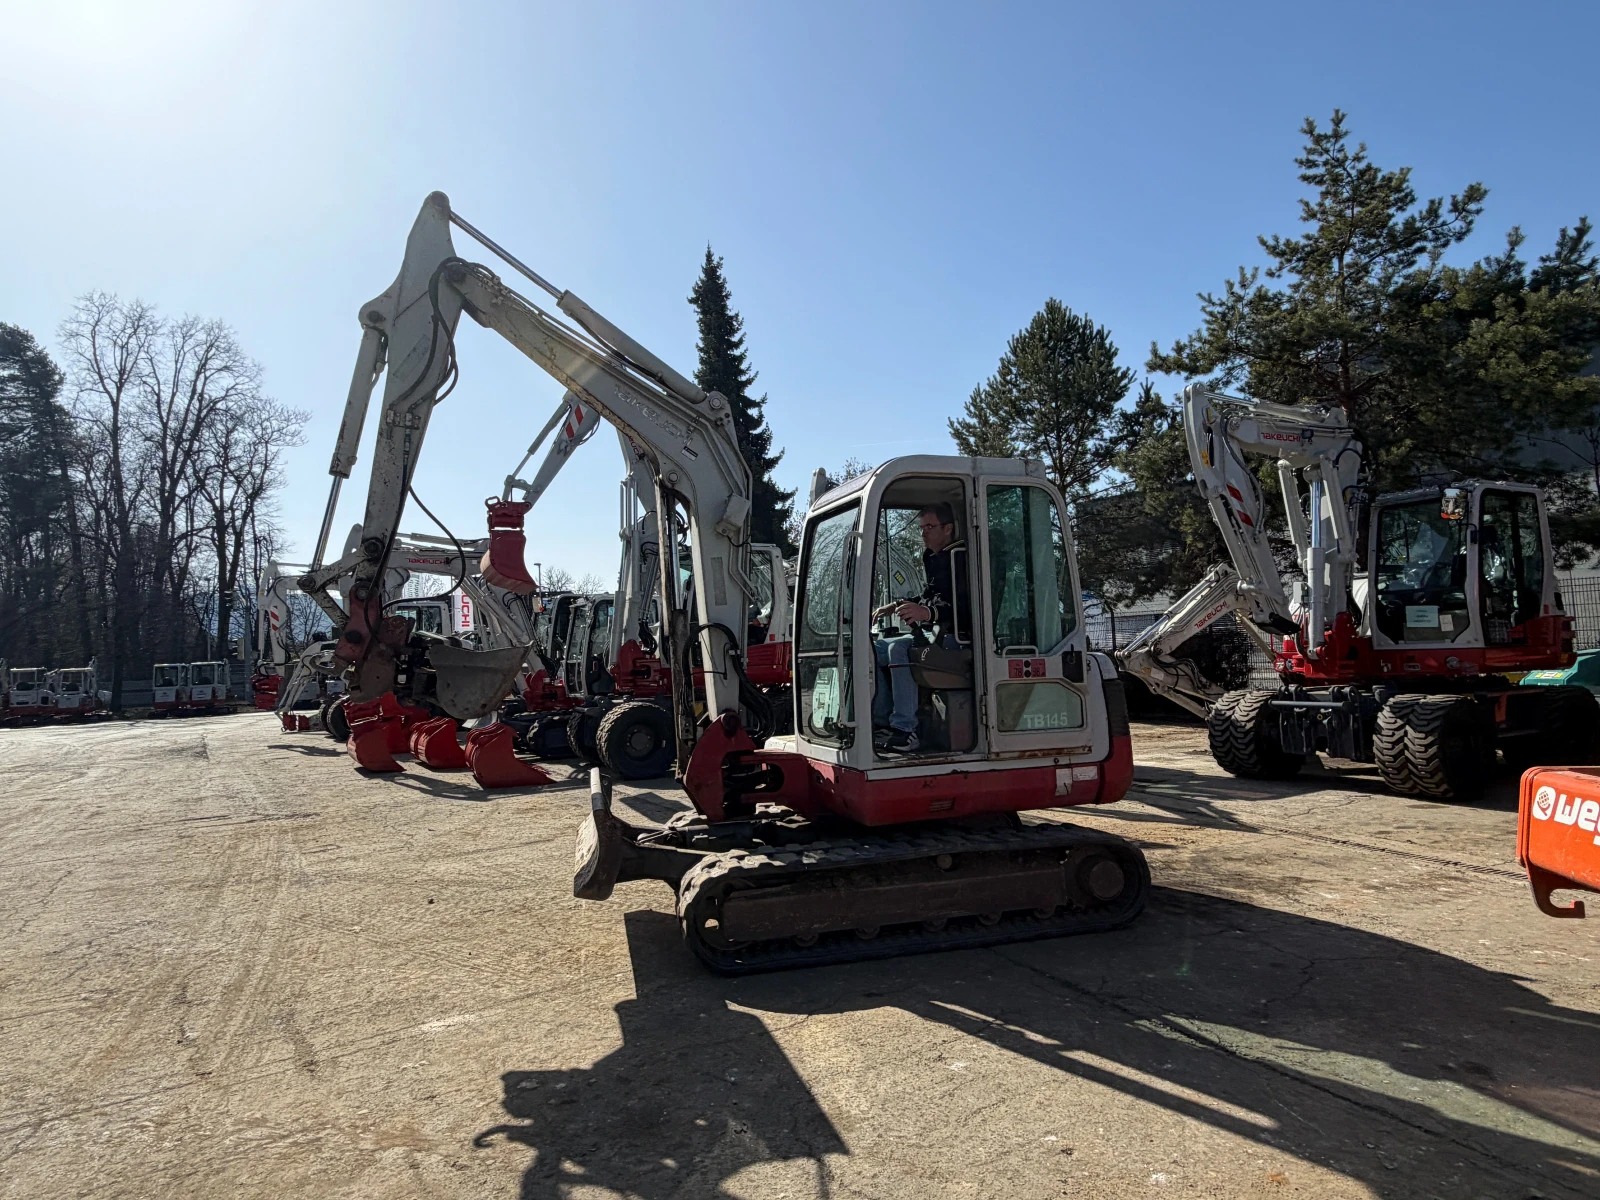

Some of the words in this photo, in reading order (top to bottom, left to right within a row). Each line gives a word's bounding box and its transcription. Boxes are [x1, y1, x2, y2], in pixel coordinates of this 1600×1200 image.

[407, 557, 446, 566] TAKEUCH
[461, 591, 470, 627] UCHI
[1023, 712, 1069, 729] TB145
[1553, 793, 1600, 847] we
